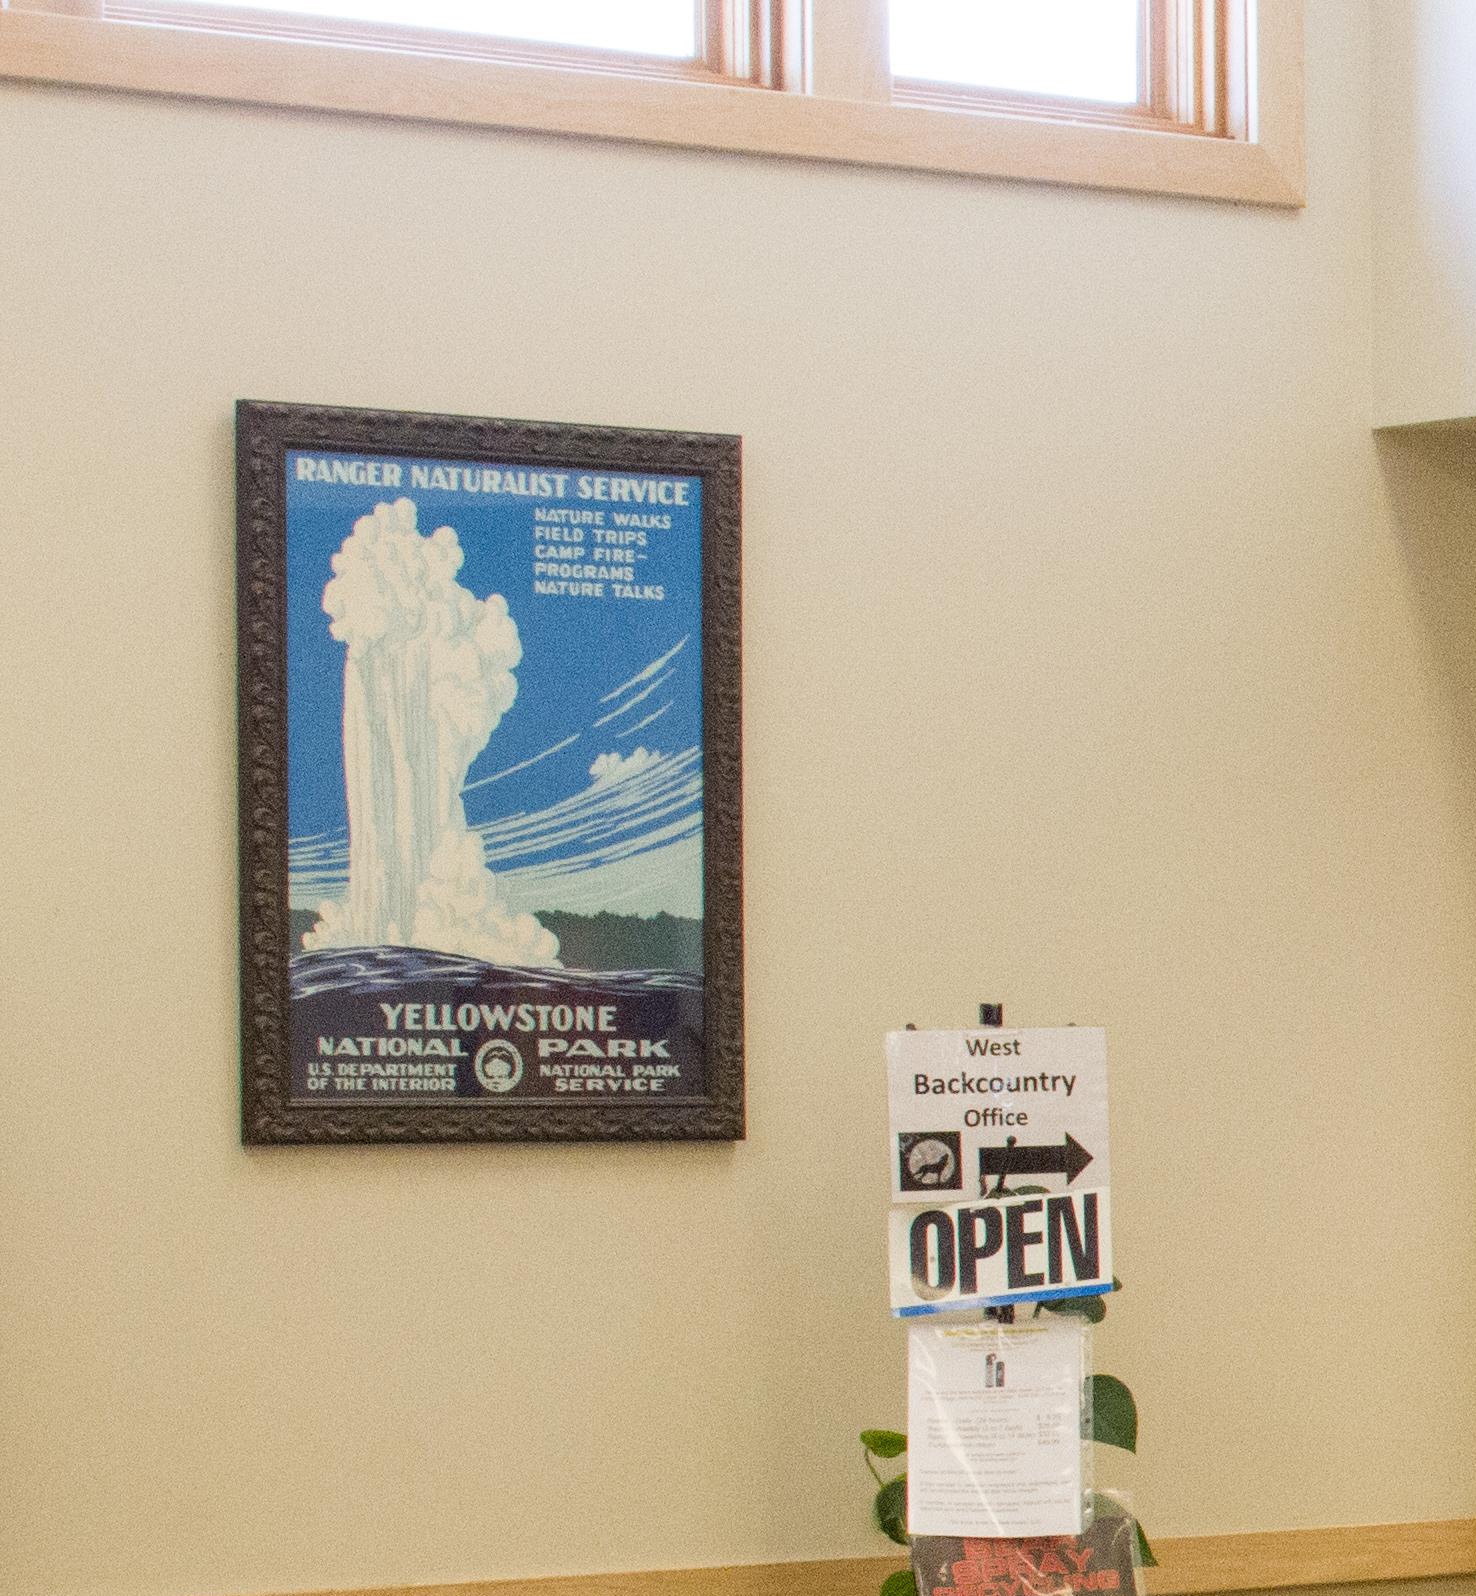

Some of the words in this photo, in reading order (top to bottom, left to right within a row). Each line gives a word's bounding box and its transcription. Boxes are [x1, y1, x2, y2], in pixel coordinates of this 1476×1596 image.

[296, 457, 400, 487] RANGER
[411, 466, 566, 498] NATURALIST
[577, 476, 690, 506] SERVICE
[533, 507, 602, 525] NATURE
[614, 511, 672, 529] WALKS
[533, 527, 583, 543] FIELD
[593, 530, 647, 547] TRIPS
[533, 545, 585, 561] CAMP
[533, 563, 635, 581] PROGRAMS
[533, 580, 602, 598] NATURE
[614, 583, 666, 601] TALKS
[379, 1003, 618, 1032] YELLOWSTONE
[318, 1037, 469, 1056] NATIONAL
[537, 1038, 671, 1058] PARK
[965, 1038, 1022, 1057] West
[337, 1063, 457, 1078] DEPARTMENT
[539, 1064, 626, 1078] NATIONAL
[633, 1065, 682, 1078] PARK
[307, 1077, 330, 1091] OF
[334, 1077, 369, 1091] THE
[372, 1077, 457, 1091] INTERIOR
[554, 1077, 667, 1092] SERVICE
[913, 1070, 1077, 1097] Backcountry
[963, 1107, 1029, 1128] Office
[909, 1193, 1100, 1301] OPEN
